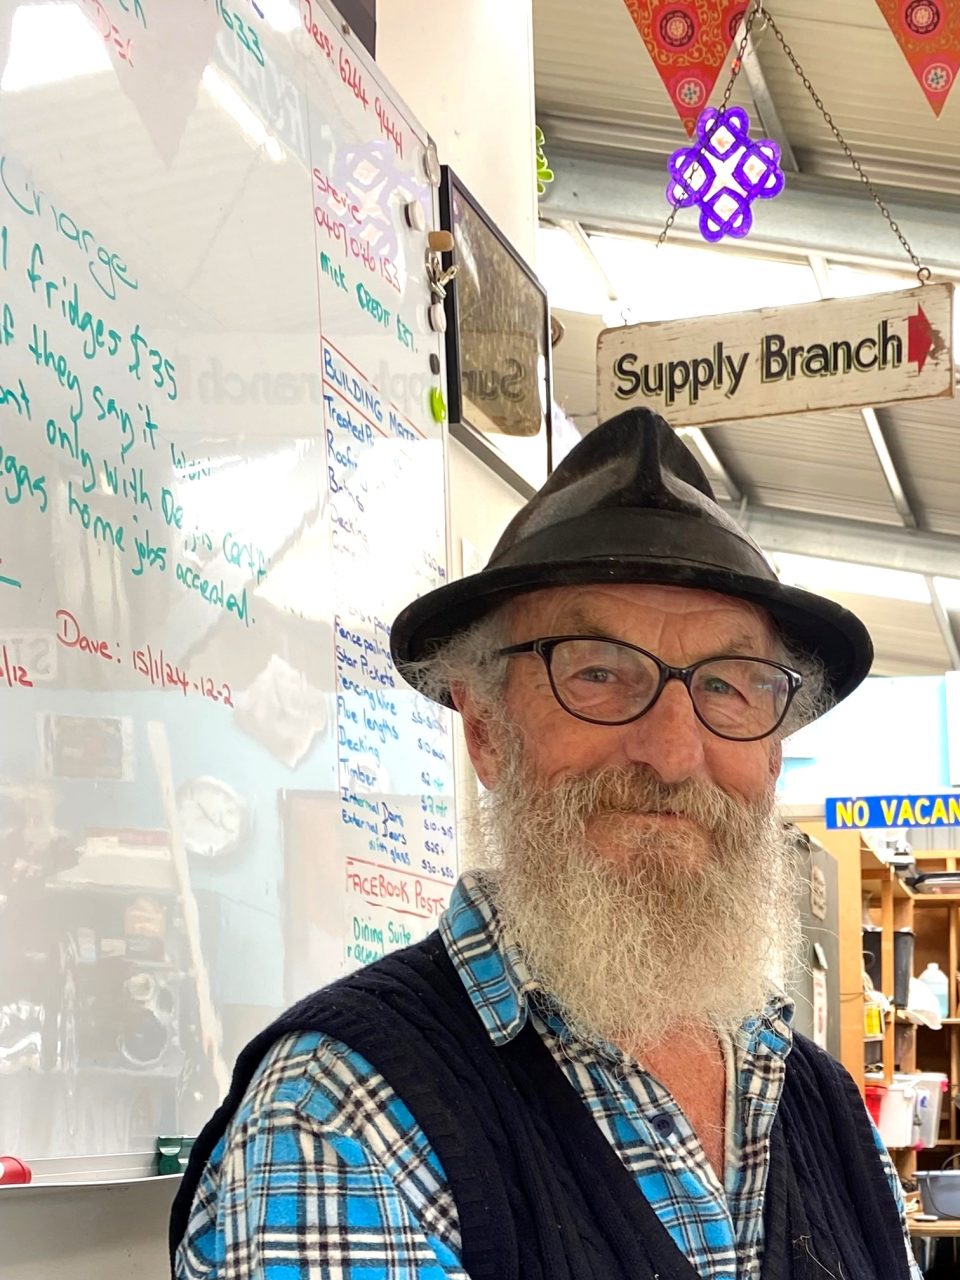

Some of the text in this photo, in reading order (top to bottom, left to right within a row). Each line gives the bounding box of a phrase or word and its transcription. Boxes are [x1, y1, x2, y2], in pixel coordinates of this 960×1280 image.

[323, 347, 383, 422] BUILDING
[613, 320, 902, 406] Supply Branch
[69, 481, 125, 553] home
[56, 609, 121, 664] Dave:
[836, 801, 870, 827] NO
[345, 861, 410, 905] FACEBOOK
[353, 916, 384, 954] Dining
